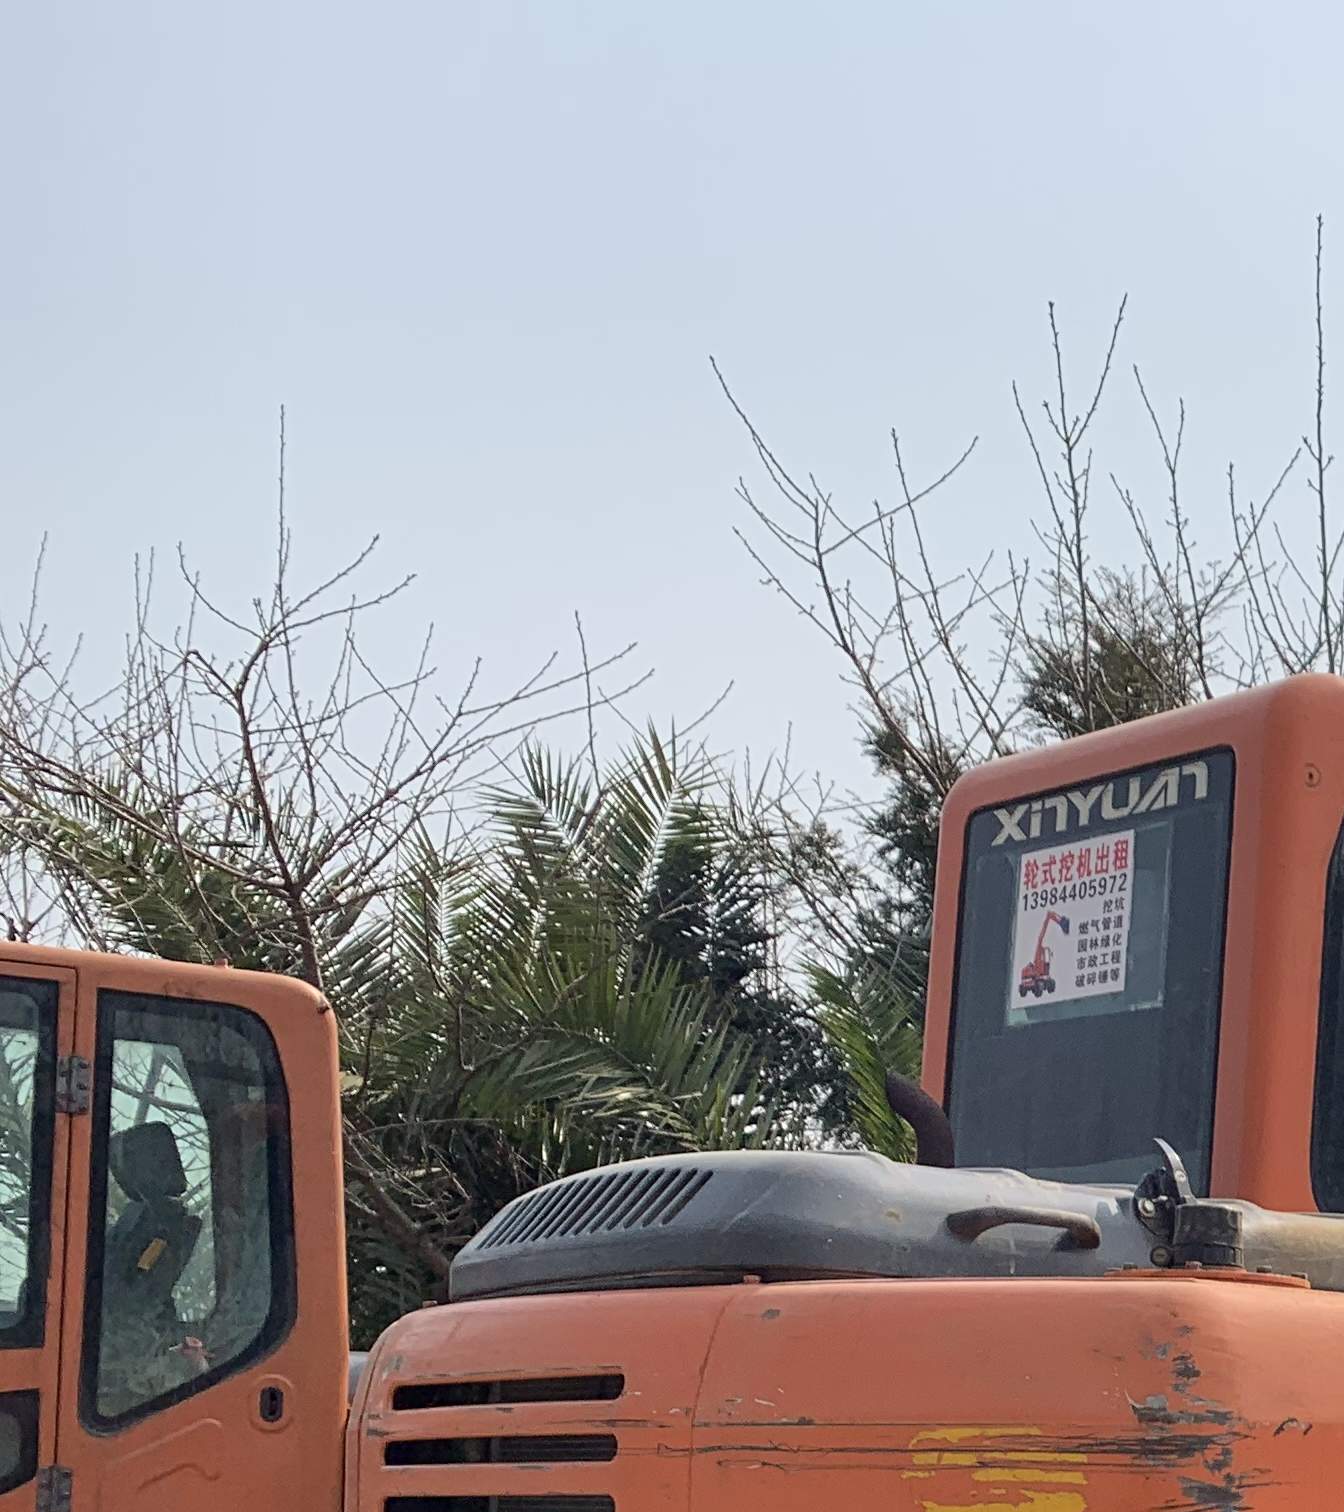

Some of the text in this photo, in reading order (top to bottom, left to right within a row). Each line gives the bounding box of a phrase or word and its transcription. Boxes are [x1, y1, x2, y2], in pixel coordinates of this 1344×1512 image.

[1023, 838, 1129, 891] 轮式挖机出租
[1023, 872, 1128, 912] 13984405972
[1078, 915, 1123, 936] 燃气管道
[1077, 932, 1122, 953] 园林绿化
[1076, 949, 1121, 971] 市政工程
